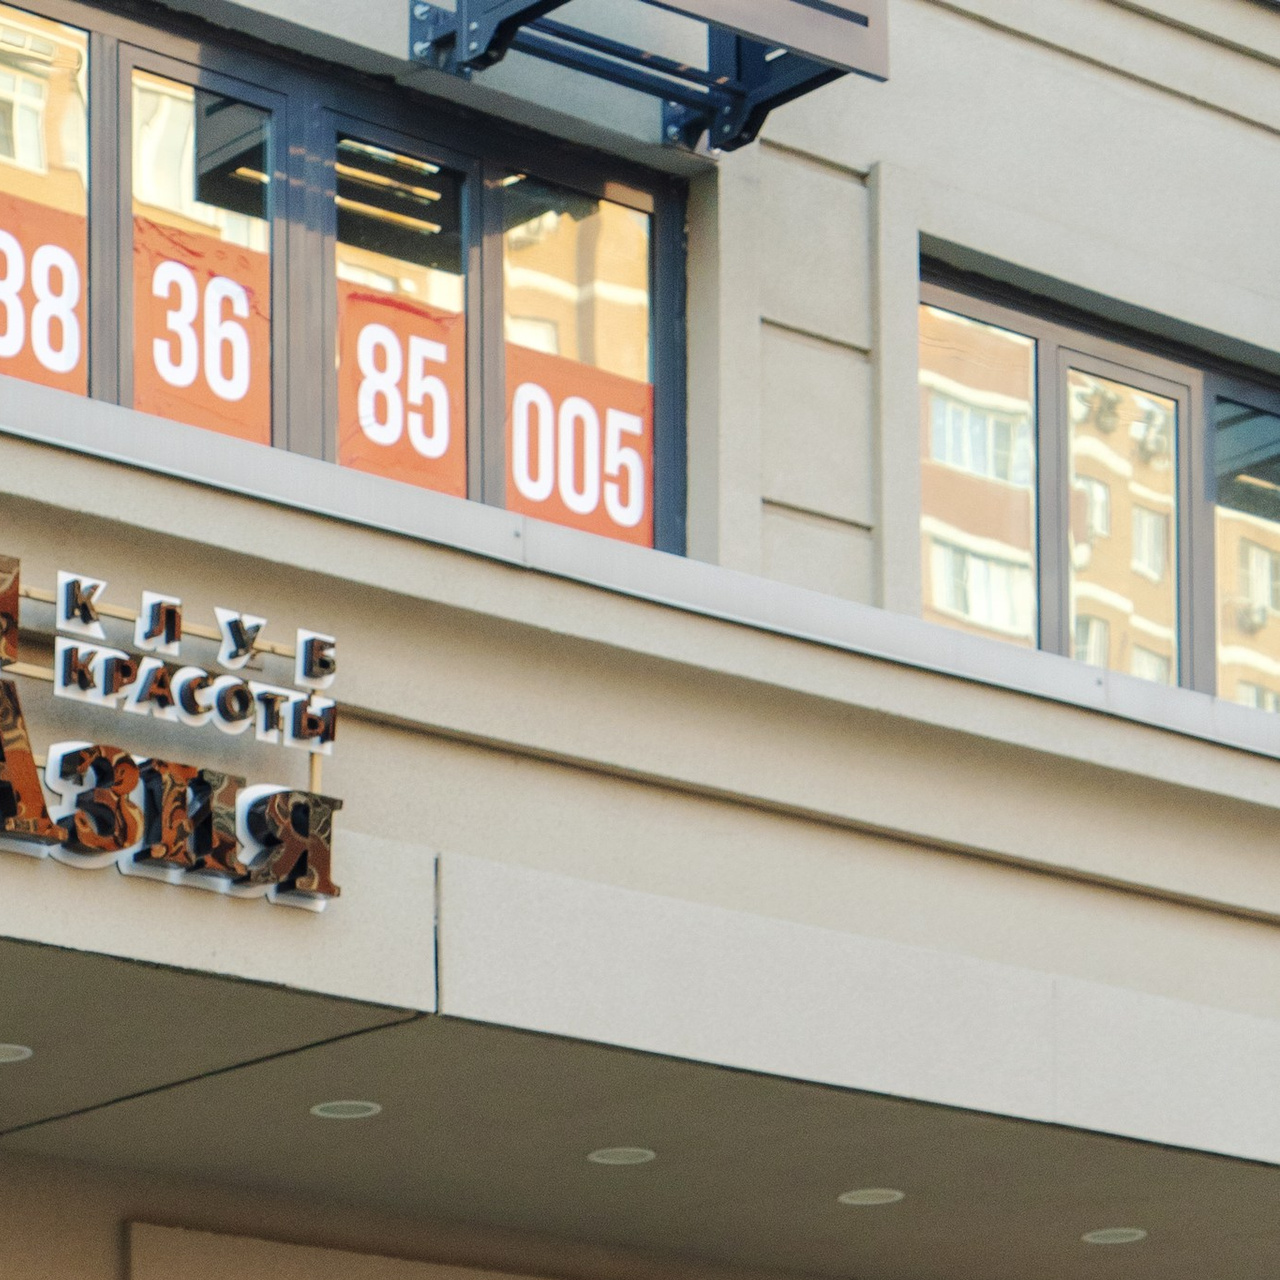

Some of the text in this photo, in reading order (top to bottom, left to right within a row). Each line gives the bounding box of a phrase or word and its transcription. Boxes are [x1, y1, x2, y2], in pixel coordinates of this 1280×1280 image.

[151, 260, 251, 401] 36
[356, 323, 450, 459] 85
[511, 382, 644, 527] 005
[56, 570, 336, 689] КЛУБ
[54, 636, 337, 756] КРАСОТЫ
